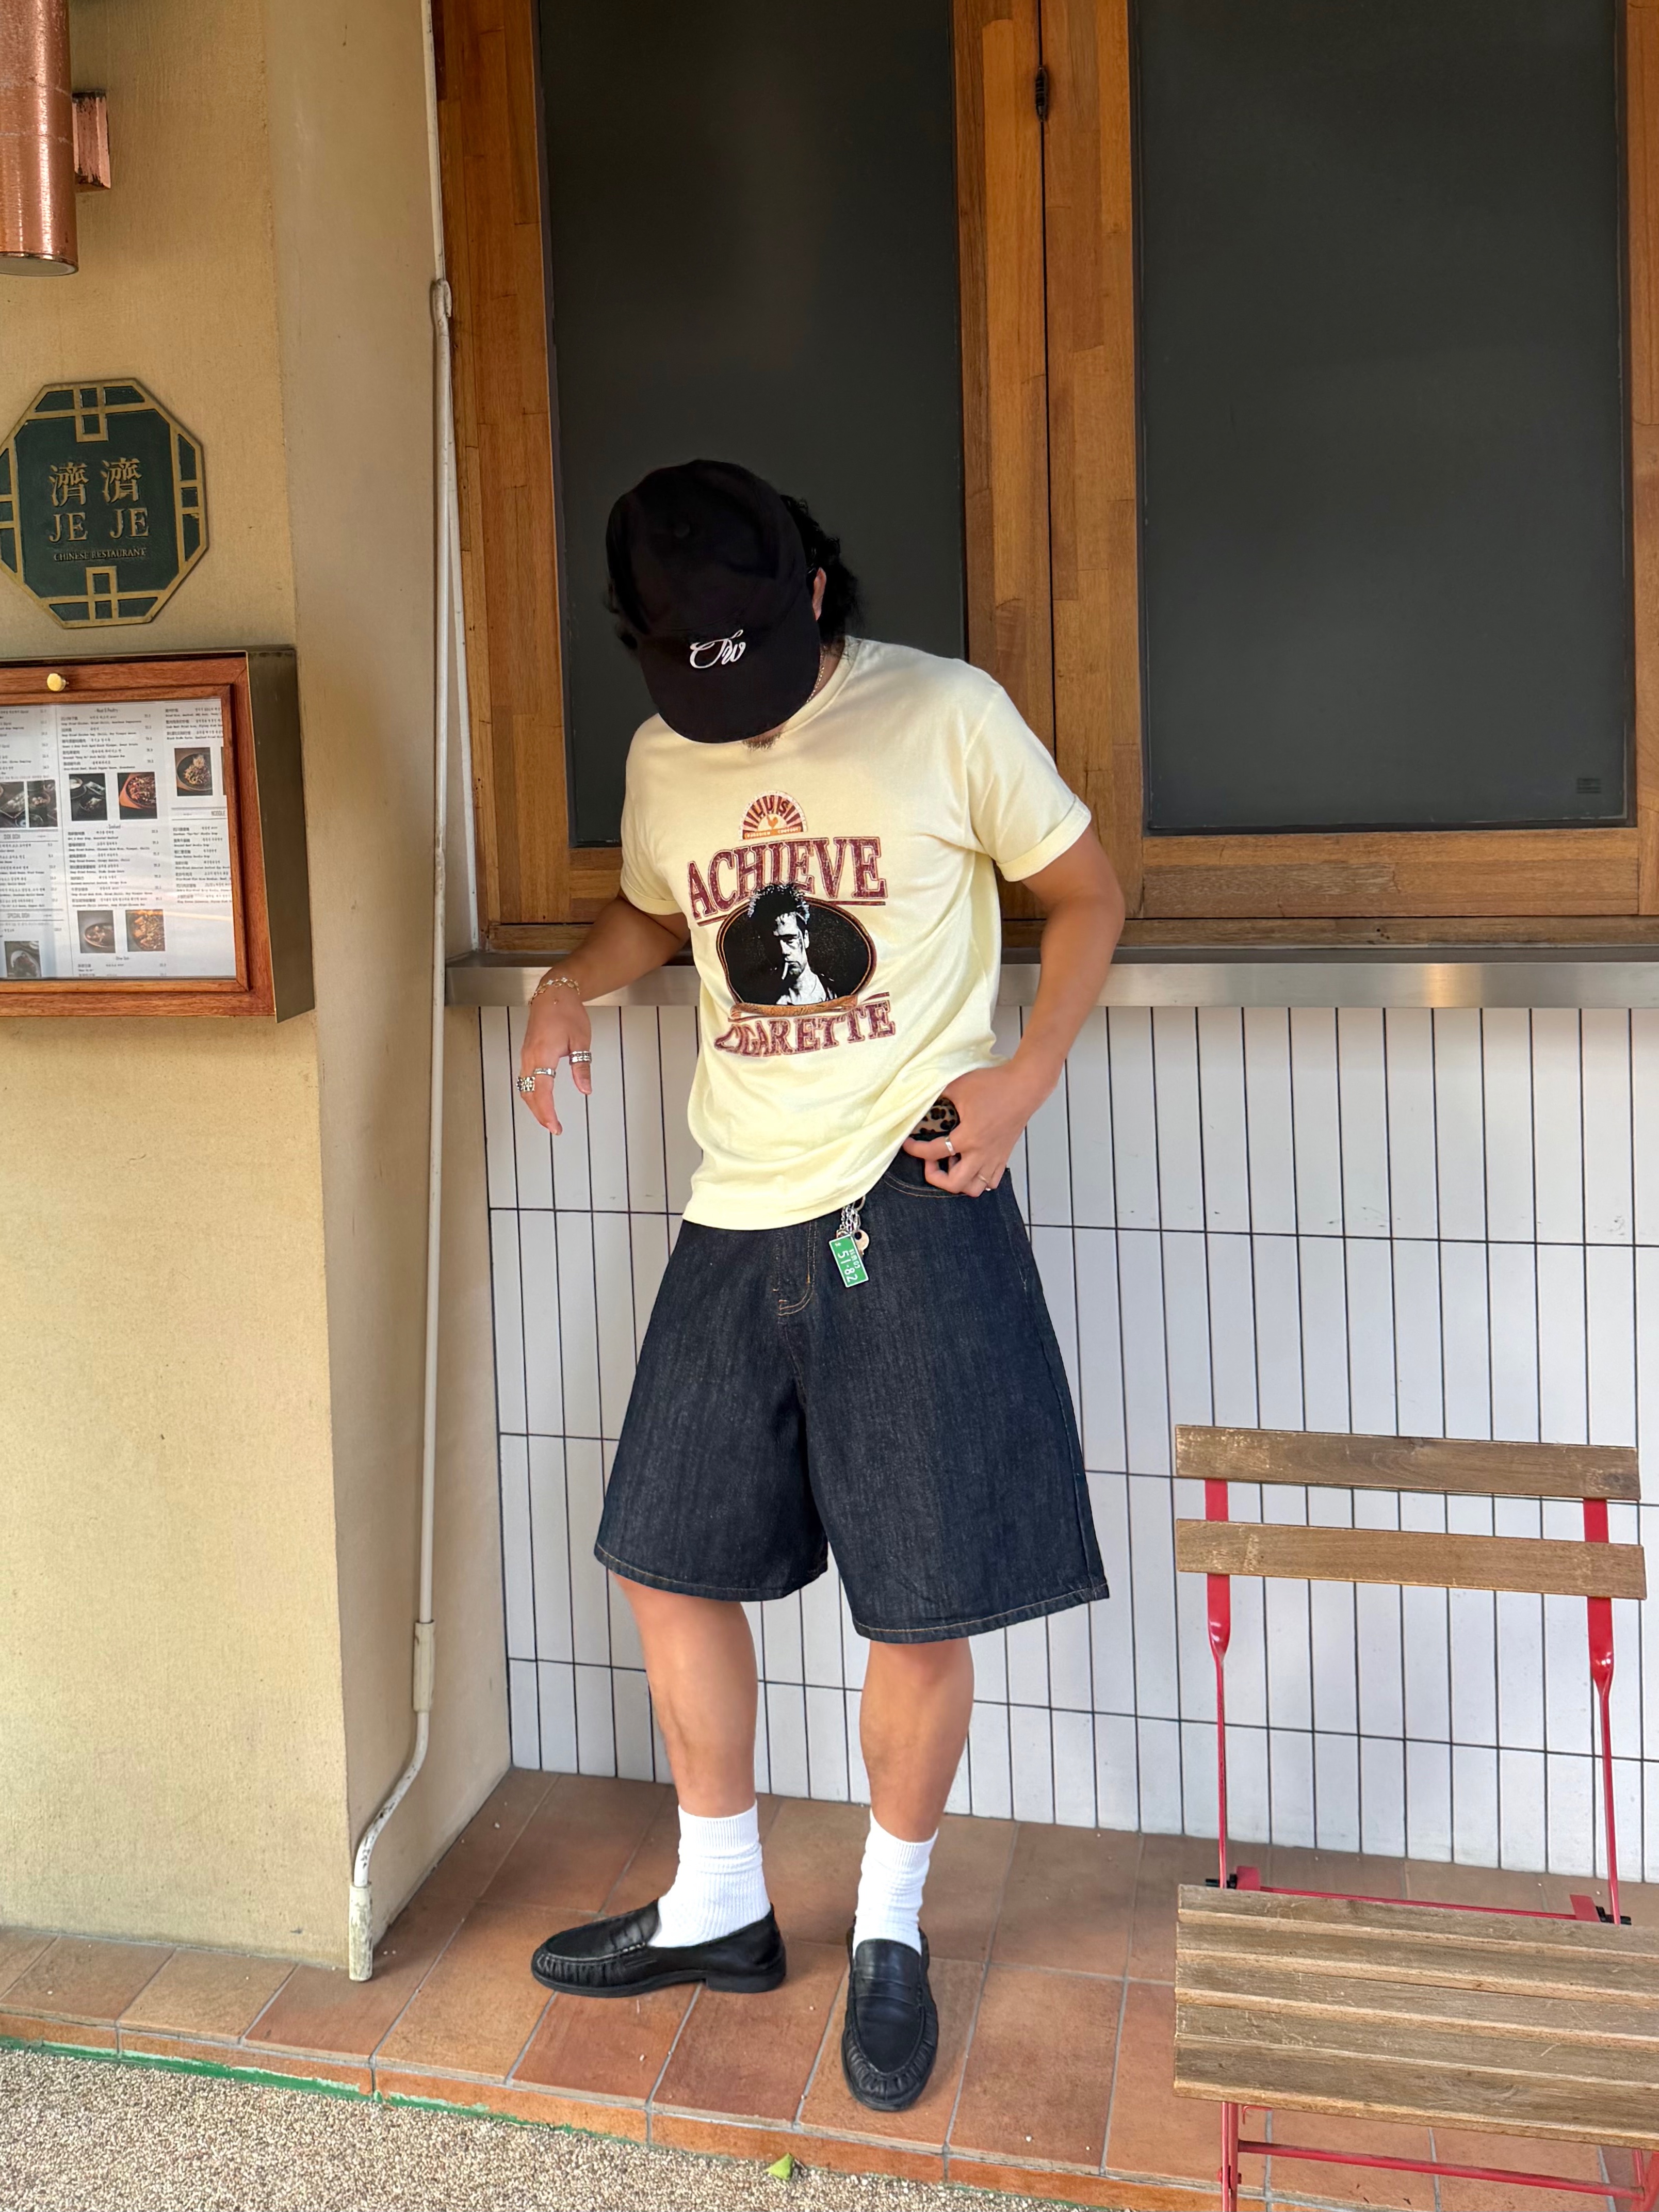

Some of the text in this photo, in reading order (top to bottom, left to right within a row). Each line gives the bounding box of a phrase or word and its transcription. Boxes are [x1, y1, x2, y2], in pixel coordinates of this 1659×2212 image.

[49, 507, 149, 542] JE JE
[54, 547, 147, 561] CHINESE RESTAURANT
[687, 836, 888, 920] ACHIEVE
